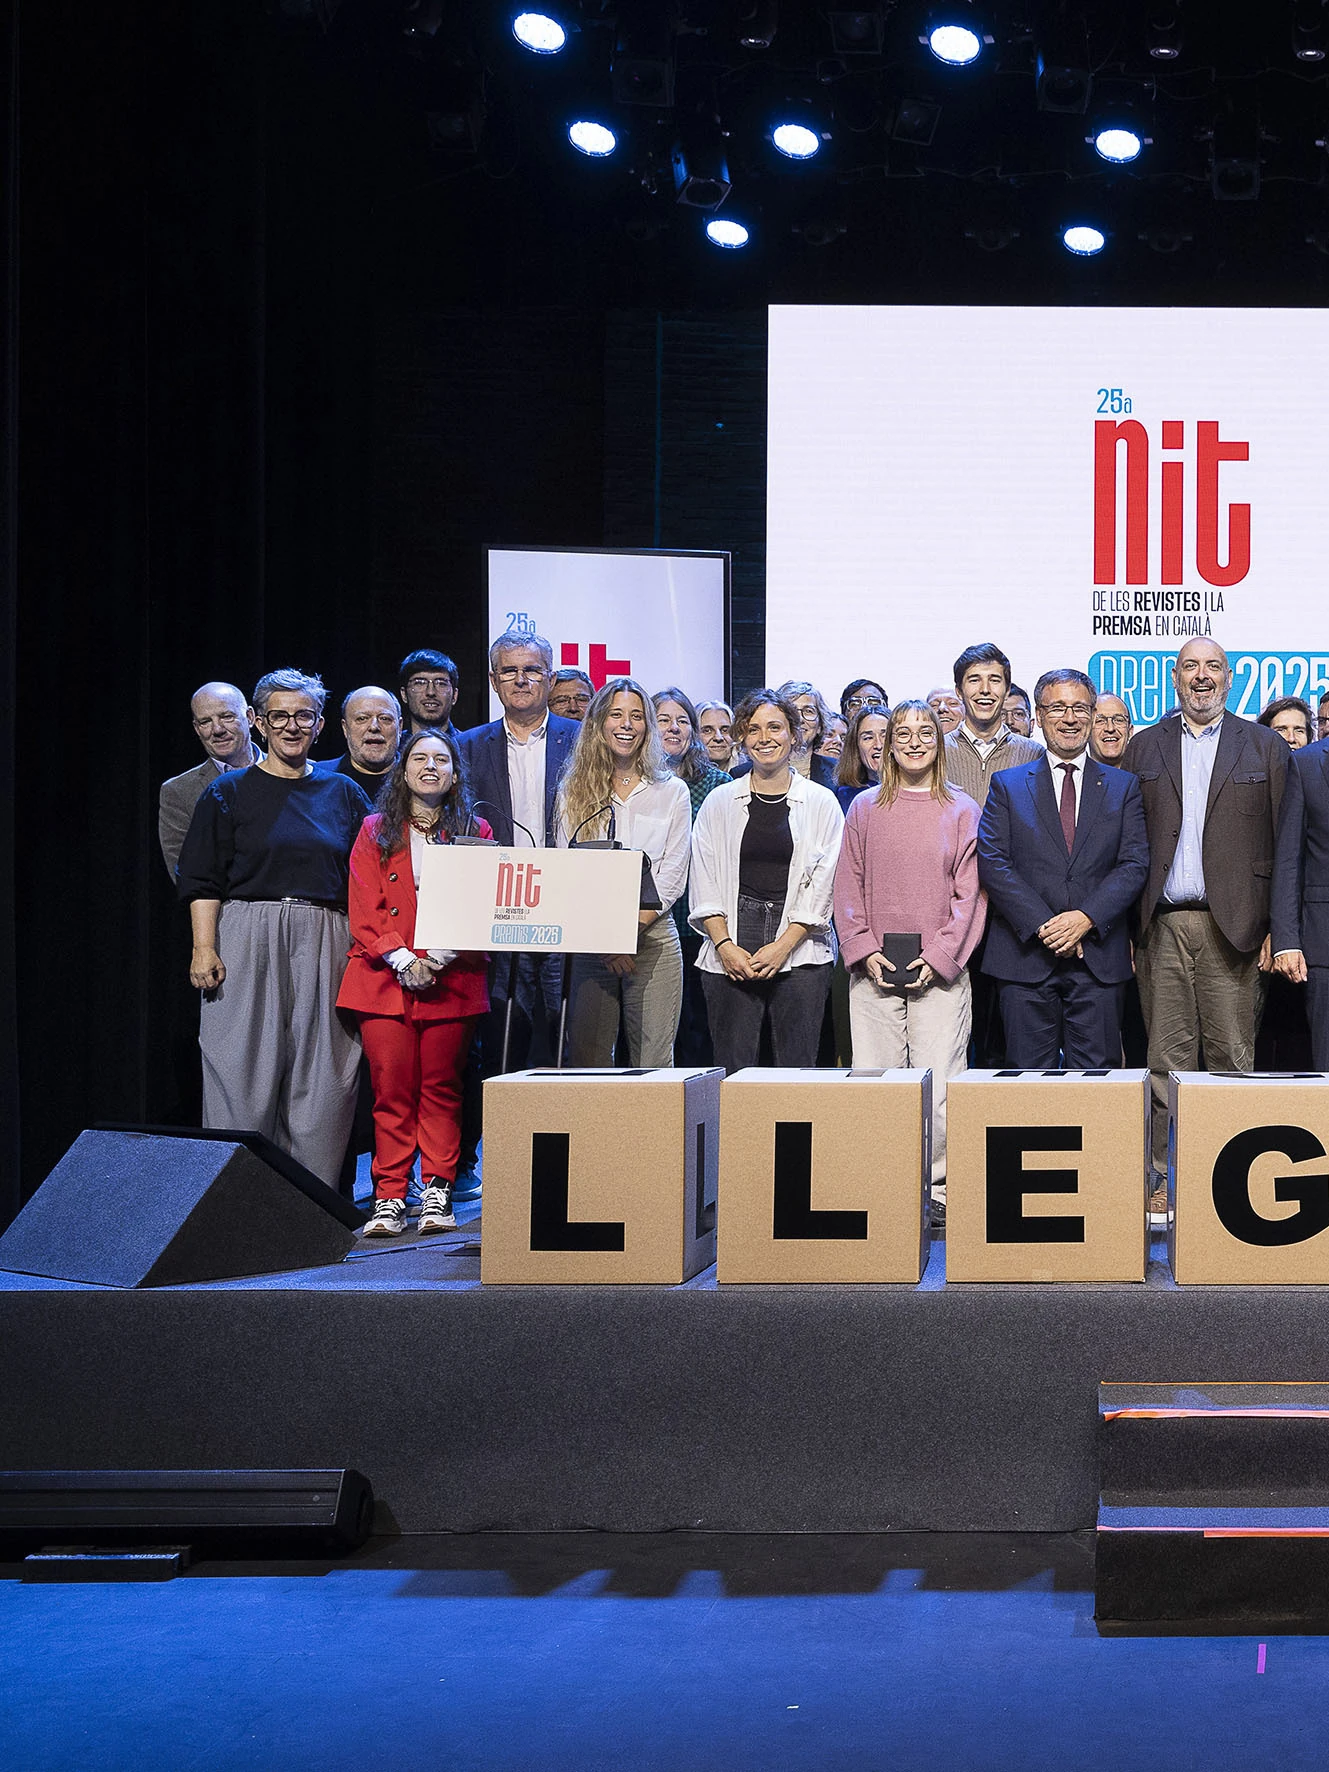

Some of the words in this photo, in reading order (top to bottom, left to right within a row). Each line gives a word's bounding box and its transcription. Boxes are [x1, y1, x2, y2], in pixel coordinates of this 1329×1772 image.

[1096, 388, 1132, 414] 25a
[1093, 419, 1251, 587] nit
[1092, 590, 1107, 612] DE
[1110, 590, 1130, 612] LES
[1133, 591, 1201, 612] REVISTES
[1210, 591, 1225, 612] LA
[506, 611, 536, 633] 25a
[1092, 615, 1152, 636] PREMSA
[1155, 615, 1170, 636] EN
[1172, 611, 1212, 636] CATALÀ
[495, 862, 542, 908] nit
[530, 926, 559, 944] 2025
